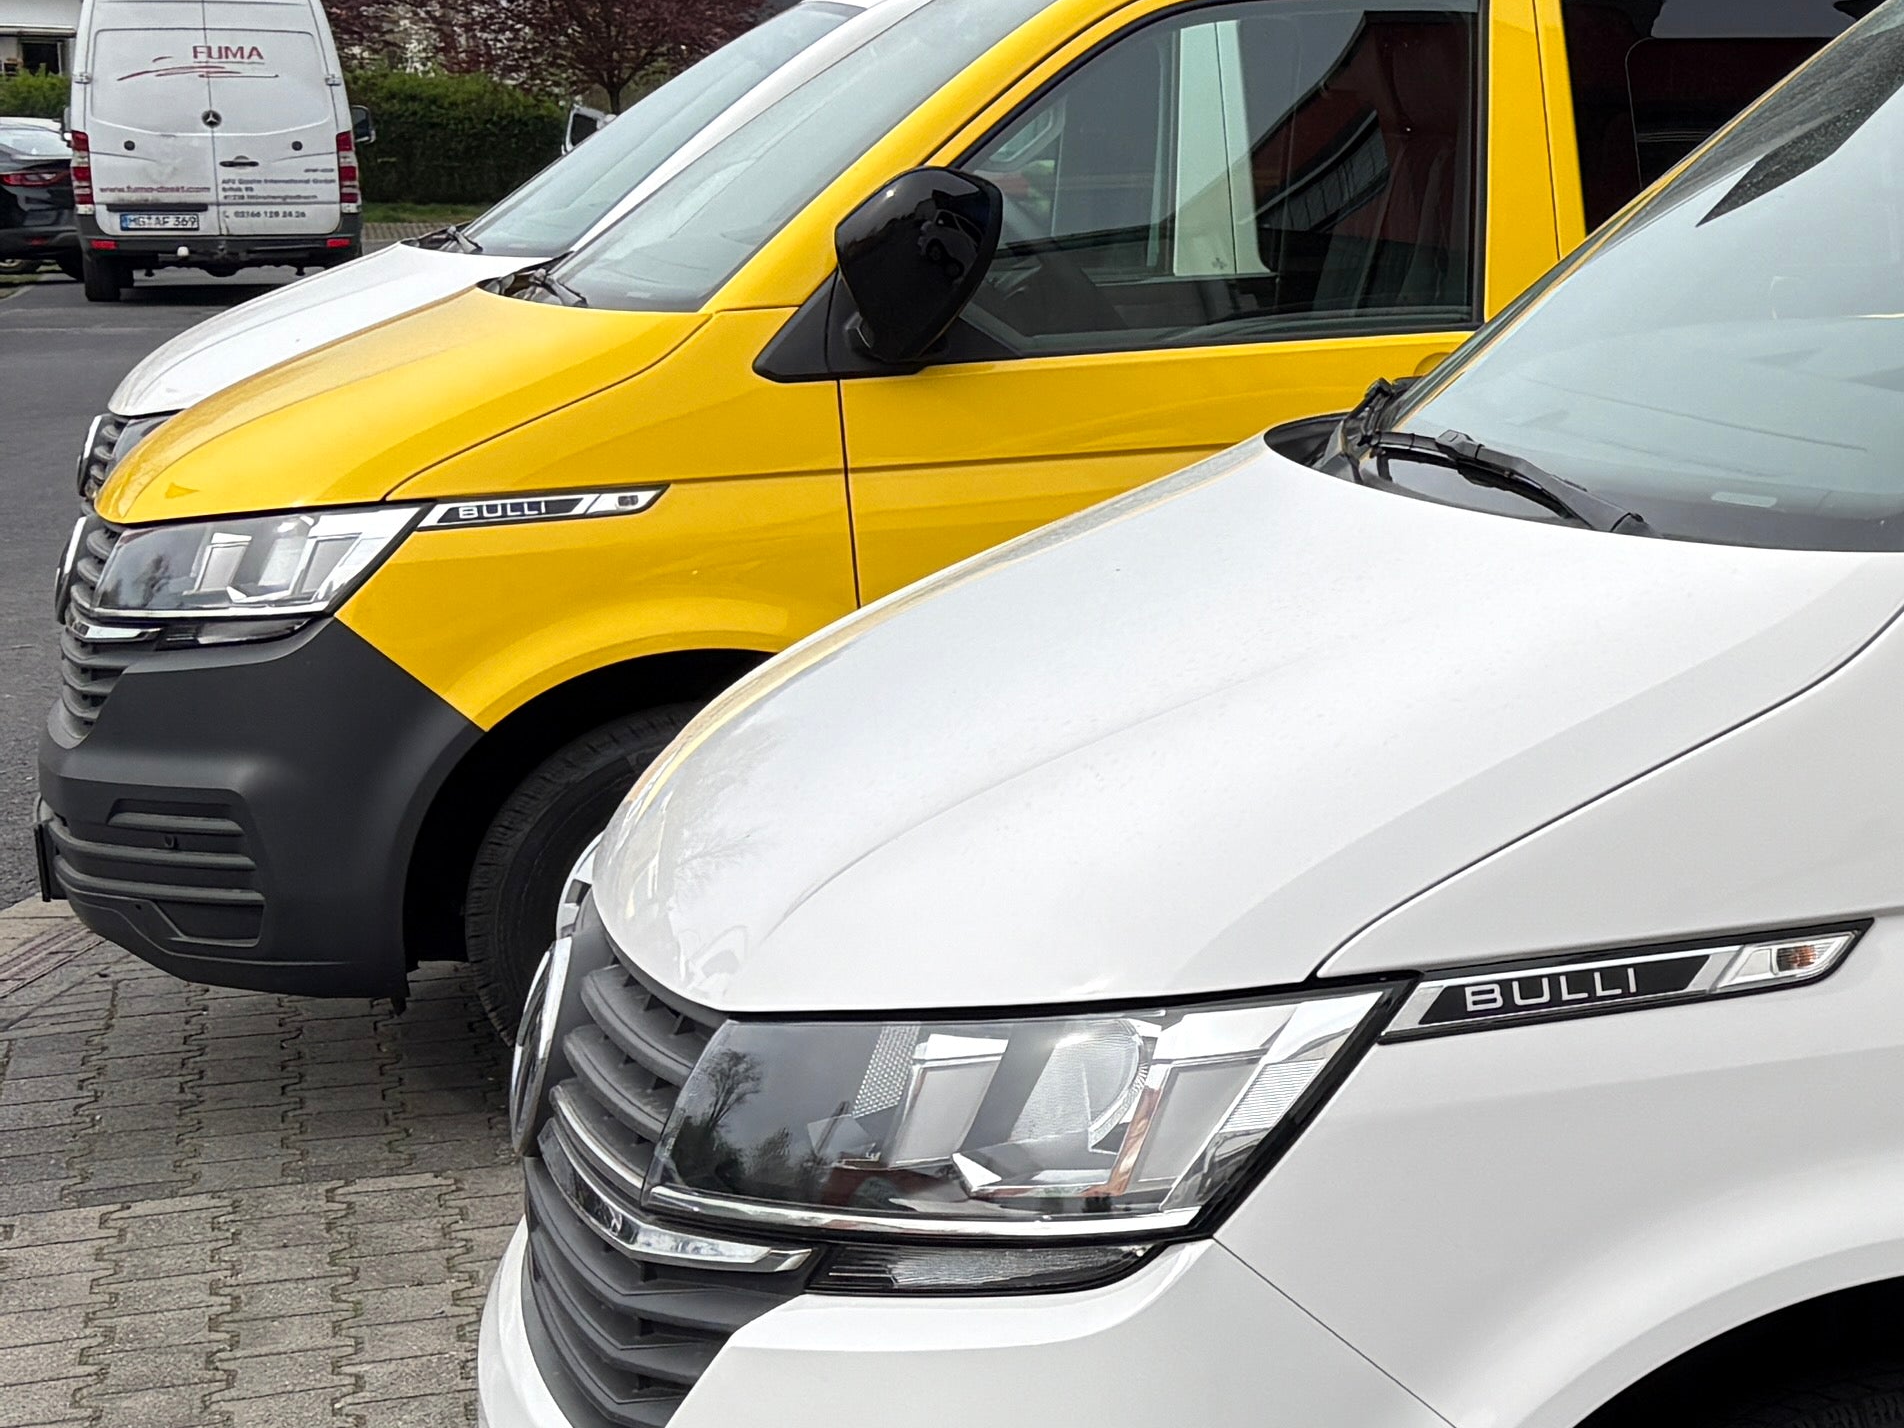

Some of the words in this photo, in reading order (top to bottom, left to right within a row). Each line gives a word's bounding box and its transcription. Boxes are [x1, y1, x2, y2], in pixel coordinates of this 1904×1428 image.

[192, 45, 264, 60] FUMA
[458, 501, 547, 520] BULLI
[1464, 966, 1639, 1013] BULLI
